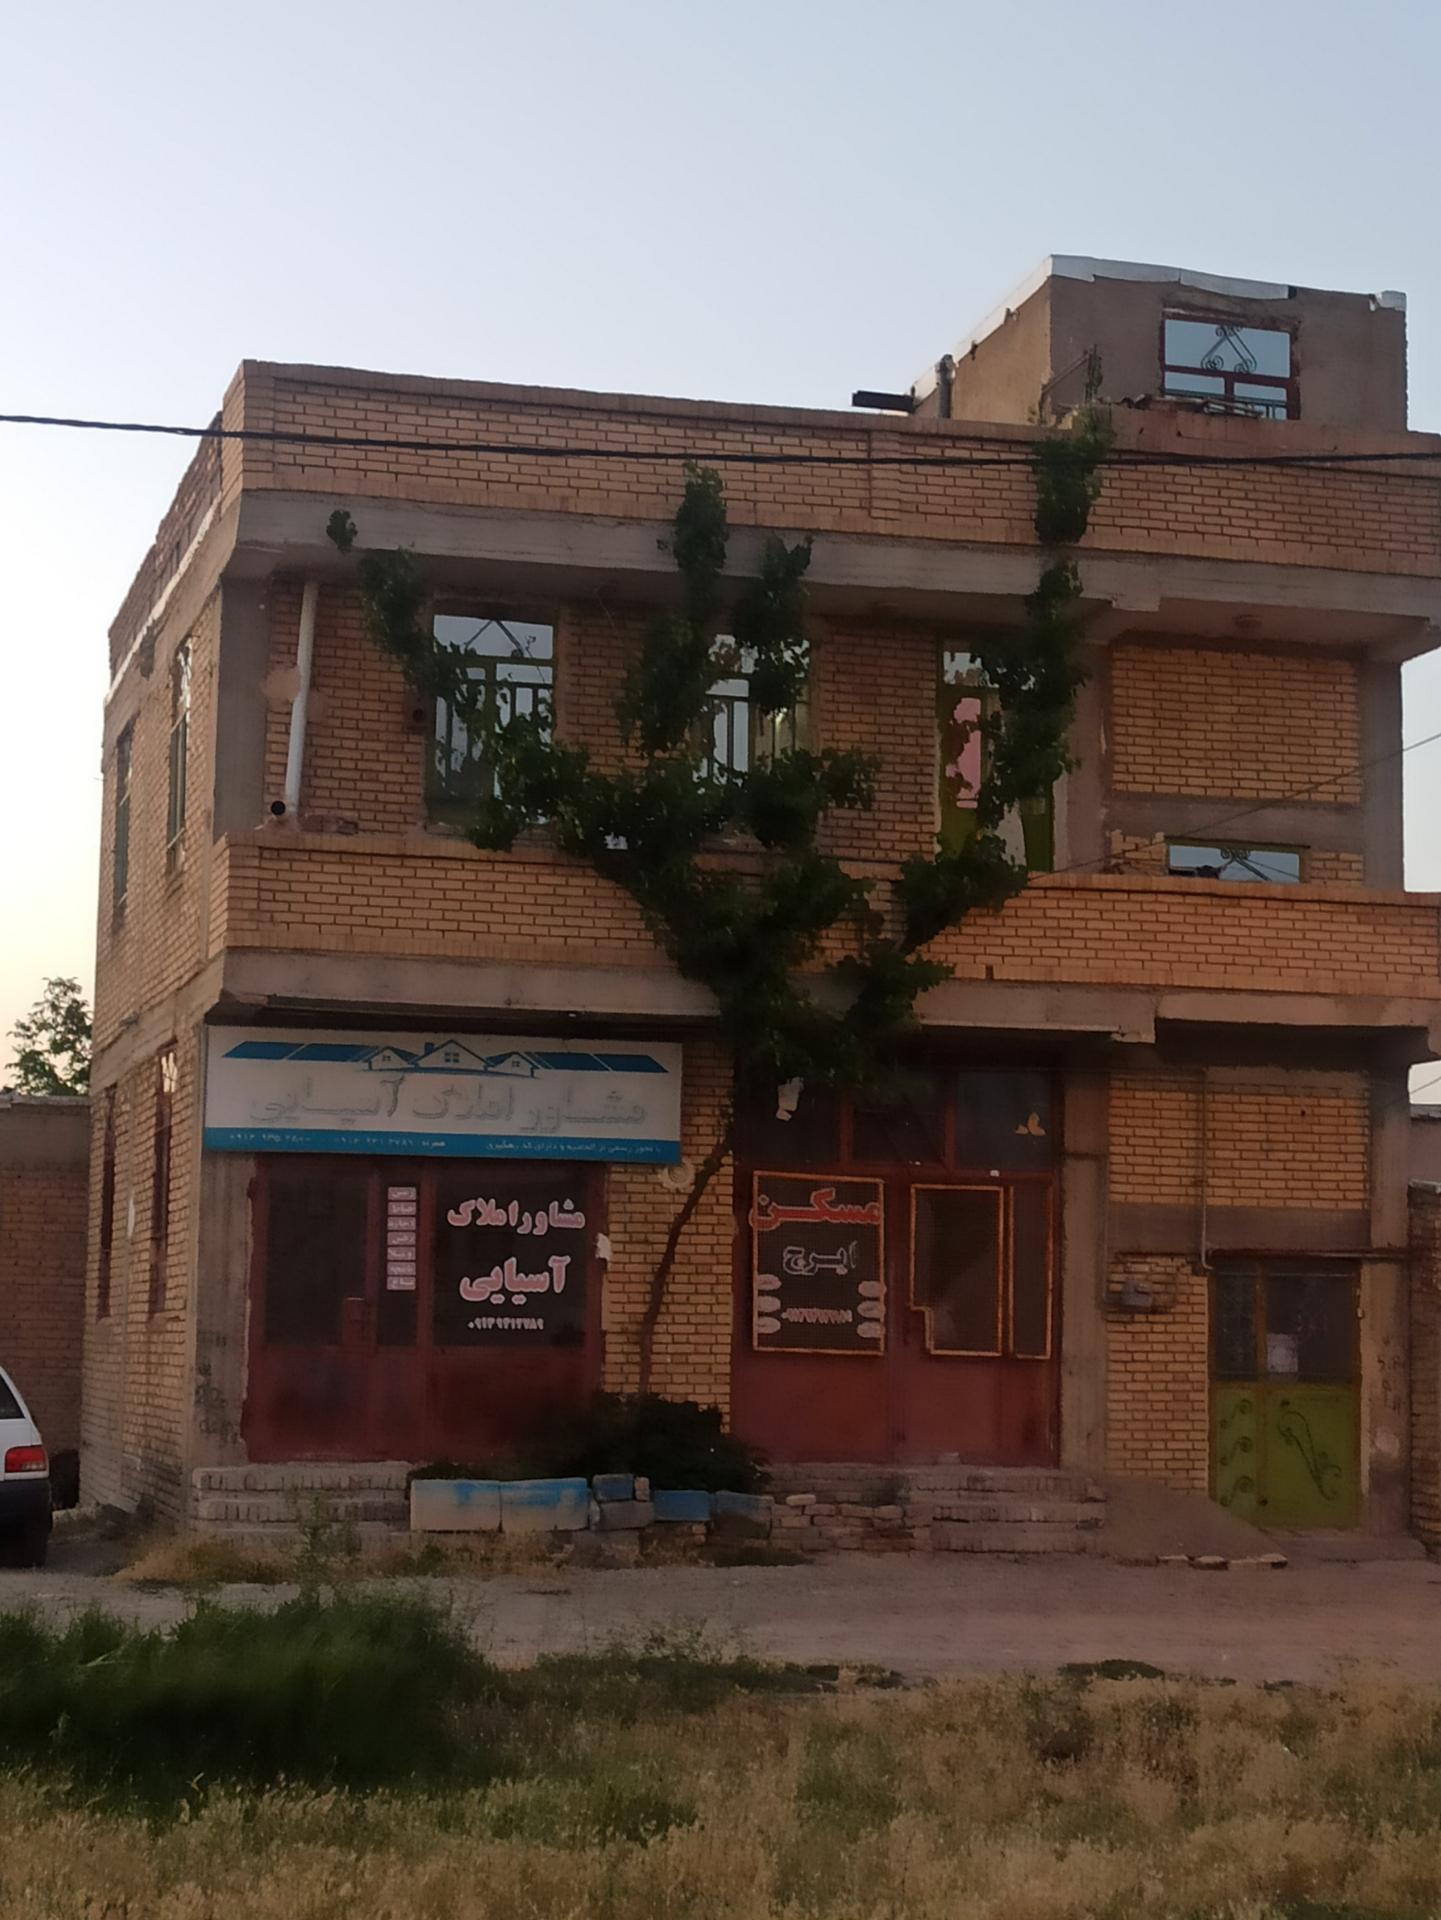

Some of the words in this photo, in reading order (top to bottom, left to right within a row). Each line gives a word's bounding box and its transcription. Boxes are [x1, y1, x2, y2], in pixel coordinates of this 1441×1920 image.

[249, 1075, 406, 1124] آسیایی
[518, 1085, 649, 1133] مشاور
[447, 1198, 519, 1226] املاک
[517, 1198, 585, 1235] مشاور
[748, 1187, 881, 1231] مسکن
[459, 1255, 571, 1305] آسیایی
